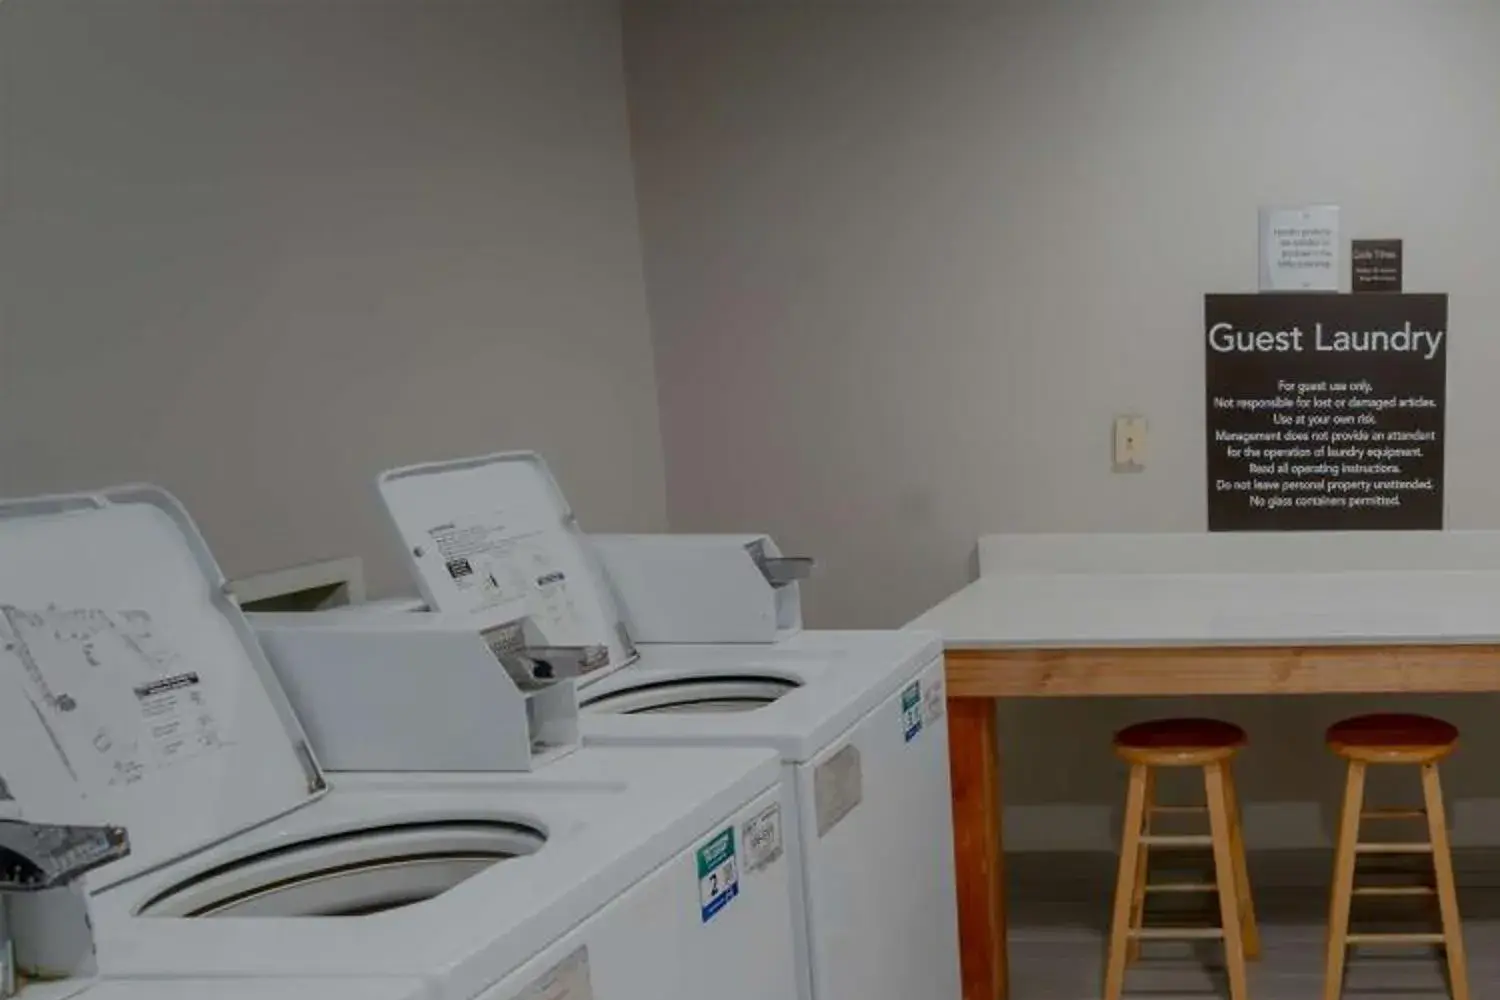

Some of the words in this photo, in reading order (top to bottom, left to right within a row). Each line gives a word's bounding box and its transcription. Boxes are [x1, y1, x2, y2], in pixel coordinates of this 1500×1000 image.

[1208, 322, 1304, 352] Guest
[1315, 320, 1443, 360] Laundry
[1278, 380, 1295, 391] For
[1297, 382, 1327, 396] guest
[1330, 383, 1347, 391] use
[1349, 380, 1373, 394] only.
[1213, 397, 1234, 408] Not
[1236, 397, 1294, 412] responsible
[1296, 396, 1311, 408] for
[1313, 396, 1332, 408] lost
[1333, 399, 1345, 408] or
[1348, 396, 1397, 411] damaged
[1398, 396, 1437, 408] articles.
[1273, 413, 1293, 425] Use
[1296, 414, 1306, 425] at
[1308, 415, 1330, 427] your
[1333, 415, 1355, 425] own
[1357, 412, 1376, 425] risk.
[1215, 430, 1281, 445] Management
[1283, 431, 1309, 441] does
[1311, 431, 1328, 441] not
[1331, 430, 1369, 445] provide
[1371, 432, 1385, 441] an
[1387, 429, 1436, 441] attendant
[1227, 445, 1241, 457] for
[1243, 446, 1261, 457] the
[1263, 445, 1312, 461] operation
[1314, 445, 1325, 457] of
[1327, 446, 1364, 460] laundry
[1366, 446, 1424, 460] equipment.
[1249, 462, 1275, 474] Read
[1277, 462, 1289, 474] all
[1291, 461, 1340, 477] operating
[1215, 480, 1232, 491] Do
[1233, 480, 1251, 490] not
[1253, 479, 1281, 490] leave
[1281, 479, 1325, 492] personal
[1327, 481, 1371, 493] property
[1249, 496, 1265, 507] No
[1267, 496, 1293, 510] glass
[1295, 496, 1347, 507] containers
[709, 873, 719, 897] 2
